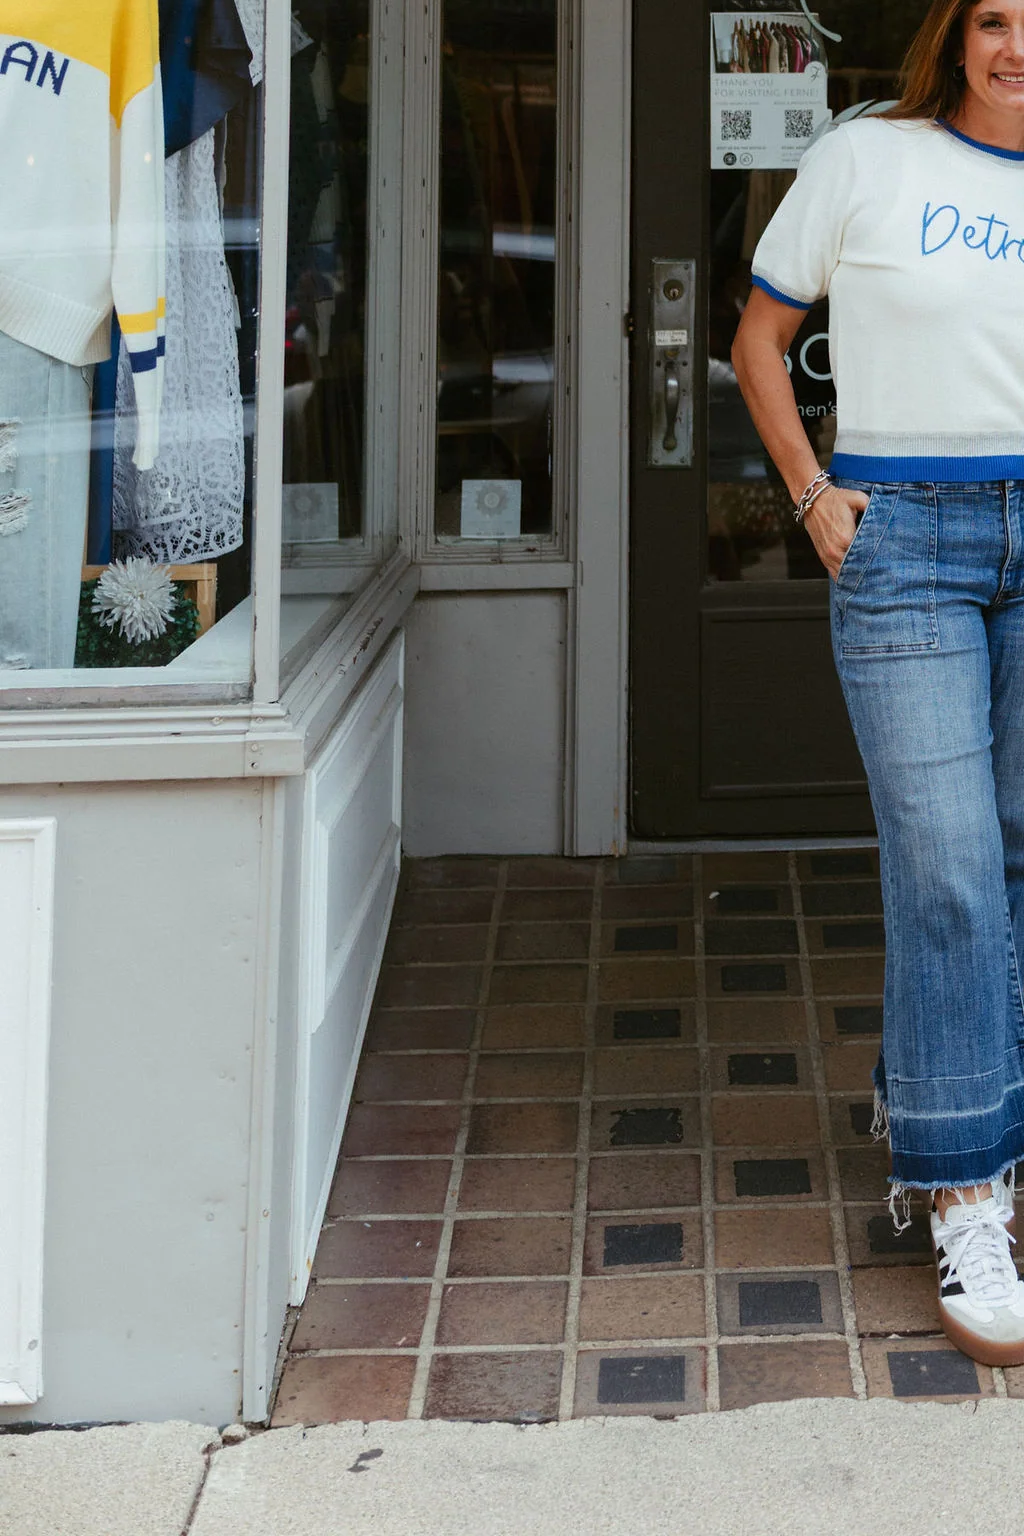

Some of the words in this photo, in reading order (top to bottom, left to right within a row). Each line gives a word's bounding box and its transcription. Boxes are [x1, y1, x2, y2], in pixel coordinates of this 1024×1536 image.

[0, 40, 71, 97] AN
[714, 78, 749, 87] THANK
[752, 78, 774, 87] YOU
[714, 88, 735, 97] FOR
[737, 88, 781, 97] VISITING
